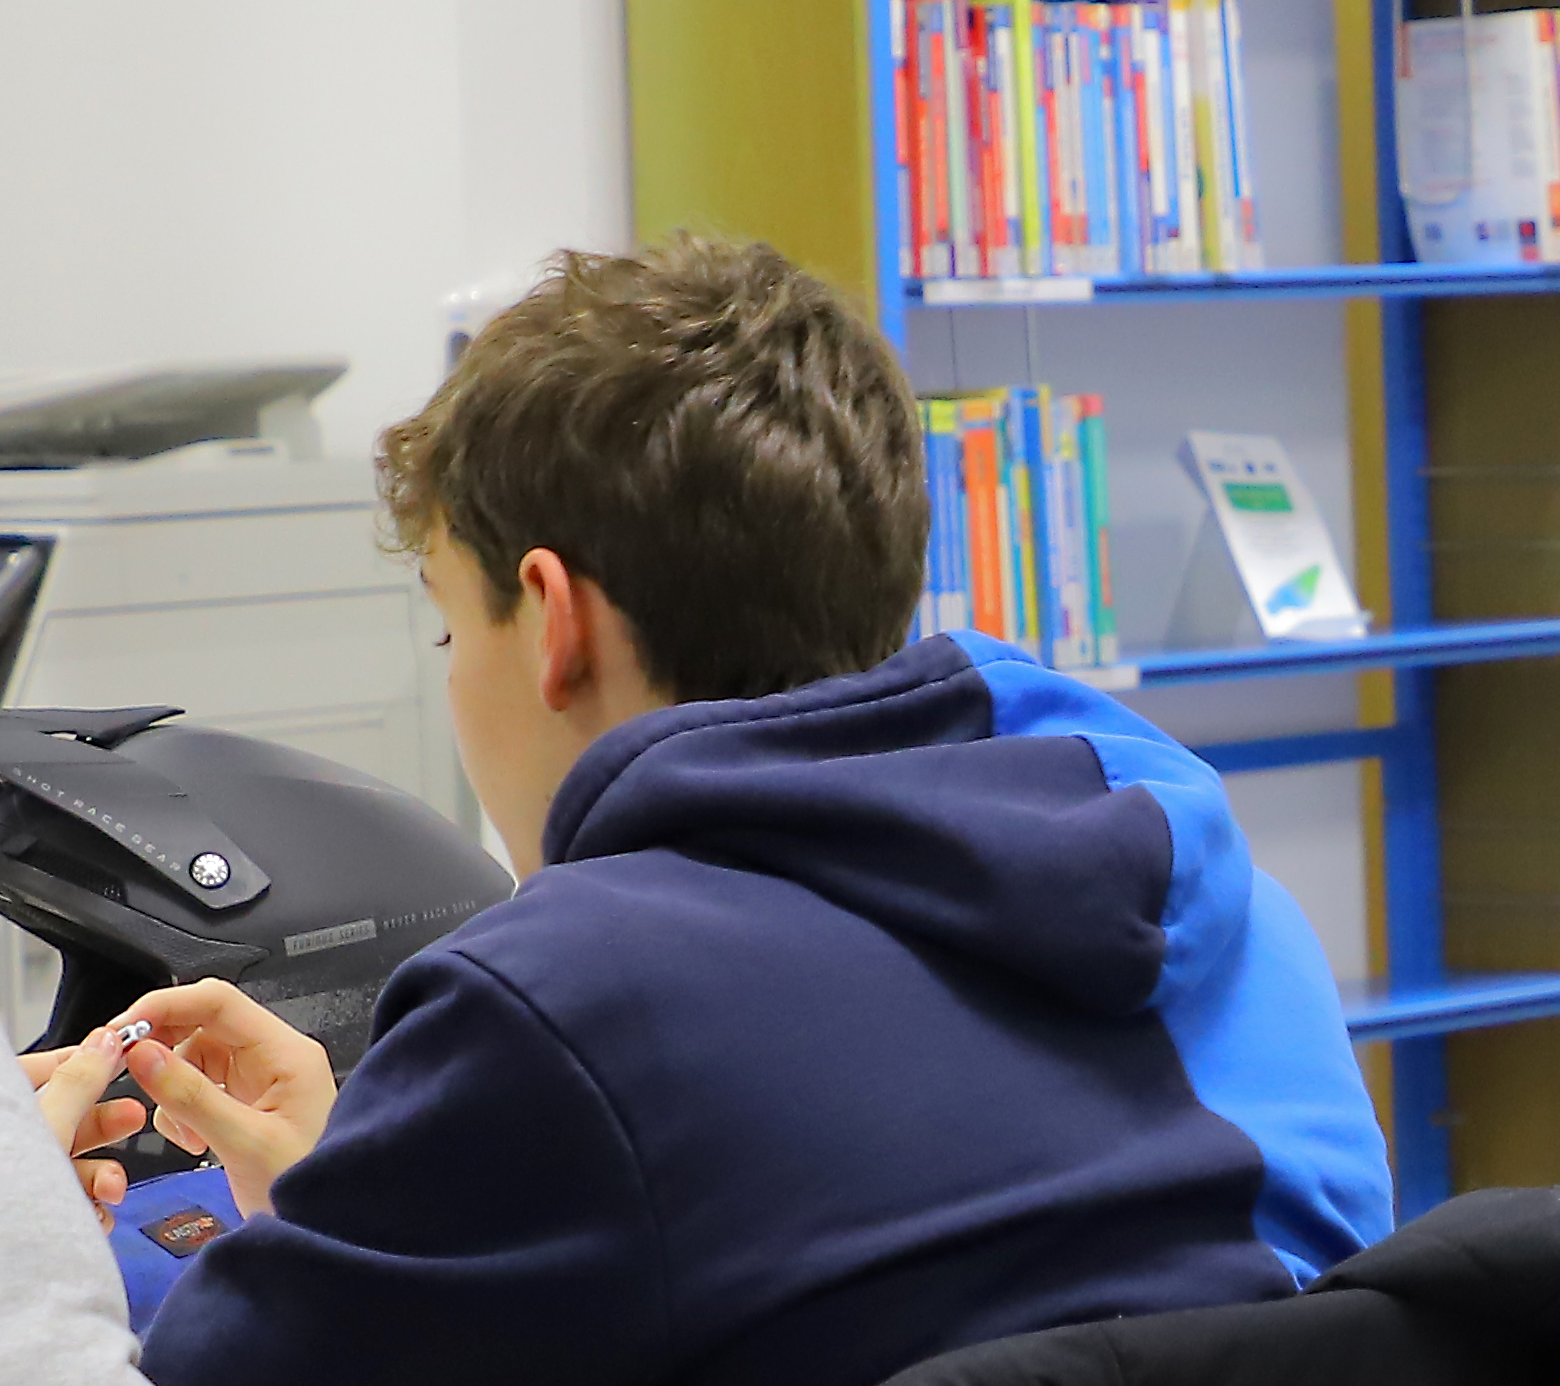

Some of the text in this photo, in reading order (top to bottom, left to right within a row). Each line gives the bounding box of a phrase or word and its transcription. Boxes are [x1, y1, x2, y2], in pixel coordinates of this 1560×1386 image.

[12, 766, 182, 872] SHOT RACE GEAR
[292, 926, 370, 951] FURIOUS SERIES
